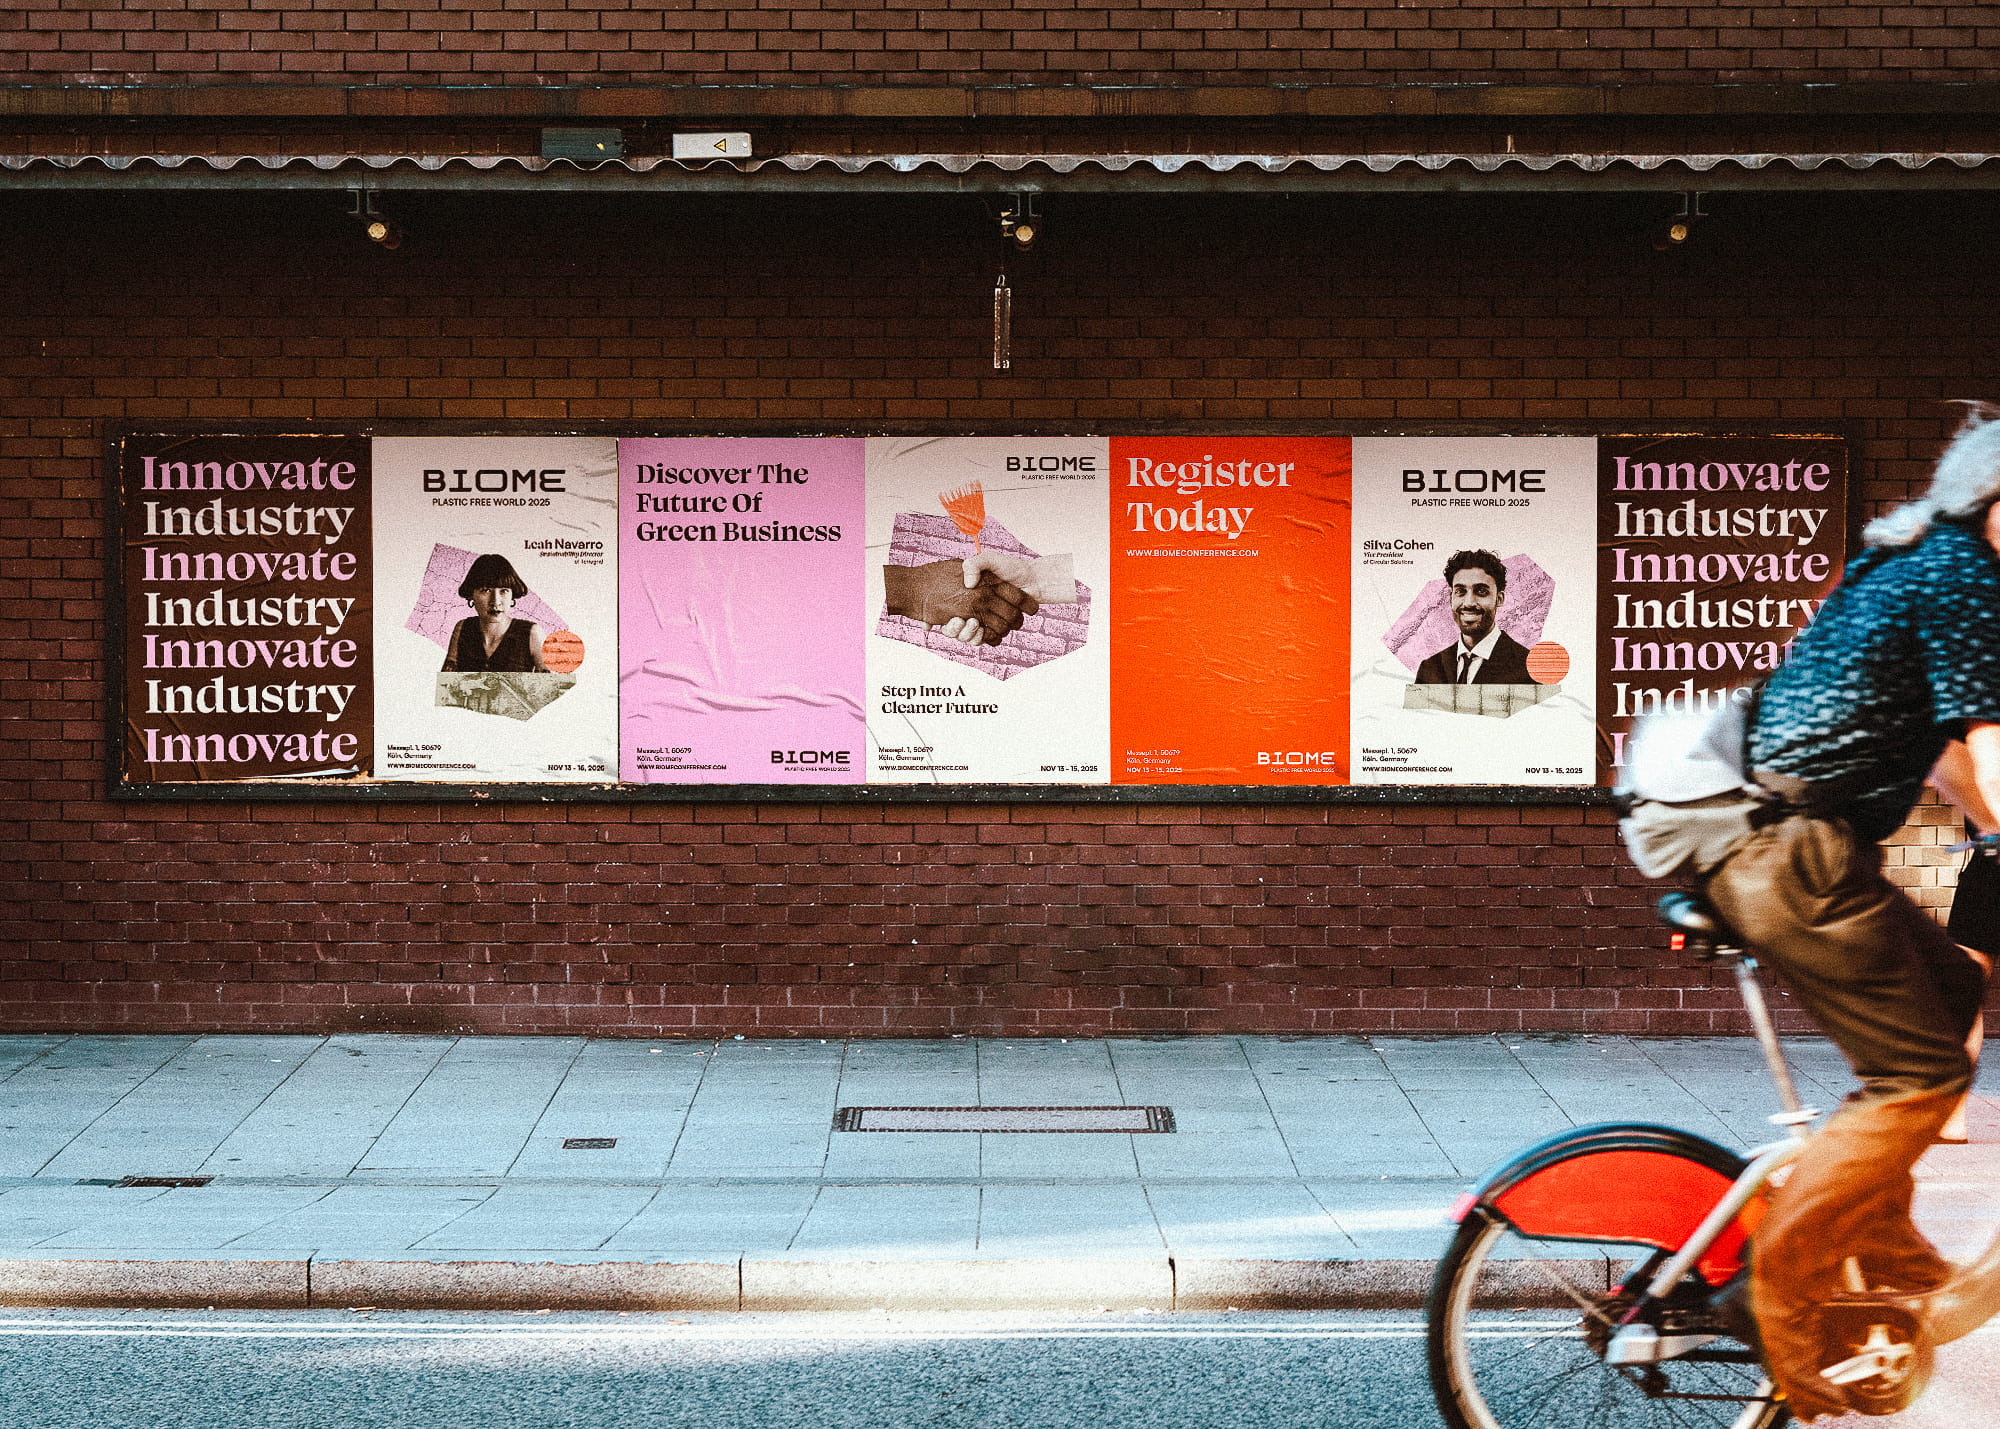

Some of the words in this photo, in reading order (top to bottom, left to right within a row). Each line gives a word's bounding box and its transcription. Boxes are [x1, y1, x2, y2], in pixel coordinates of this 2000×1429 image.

[141, 456, 356, 491] Innovate
[636, 462, 752, 485] Discover
[757, 462, 809, 485] The
[1006, 457, 1096, 471] BIOME
[1126, 455, 1295, 495] Register
[1612, 456, 1830, 491] Innovate
[423, 470, 566, 492] BIOME
[1403, 469, 1546, 492] BIOME
[432, 498, 468, 507] PLASTIC
[470, 498, 491, 507] FREE
[494, 498, 526, 507] WORLD
[528, 498, 550, 507] 2025
[636, 493, 727, 513] Future
[732, 491, 763, 513] Of
[1411, 498, 1447, 507] PLASTIC
[1449, 498, 1471, 507] FREE
[1473, 498, 1506, 507] WORLD
[1508, 498, 1530, 507] 2025
[143, 496, 355, 544] Industry
[636, 522, 718, 542] Green
[722, 520, 841, 542] Business
[1126, 499, 1254, 540] Today
[1614, 499, 1829, 545] Industry
[524, 539, 553, 550] Leah
[555, 538, 603, 550] Navarro
[1126, 549, 1259, 557] WWW.BIOMECONFERENCE.COM
[1363, 540, 1392, 550] Silva
[1394, 539, 1434, 550] Cohen
[141, 547, 357, 582] Innovate
[1611, 548, 1830, 583] Innovate
[144, 587, 355, 635] Industry
[1613, 590, 1827, 636] Industry
[142, 634, 357, 669] Innovate
[1610, 636, 1800, 672] Innovat
[145, 674, 356, 722] Industry
[881, 685, 917, 699] Step
[920, 685, 952, 697] Into
[955, 685, 966, 697] A
[881, 701, 943, 714] Cleaner
[945, 702, 999, 714] Future
[143, 728, 358, 763] Innovate
[771, 750, 850, 764] BIOME
[1257, 752, 1335, 765] BIOME
